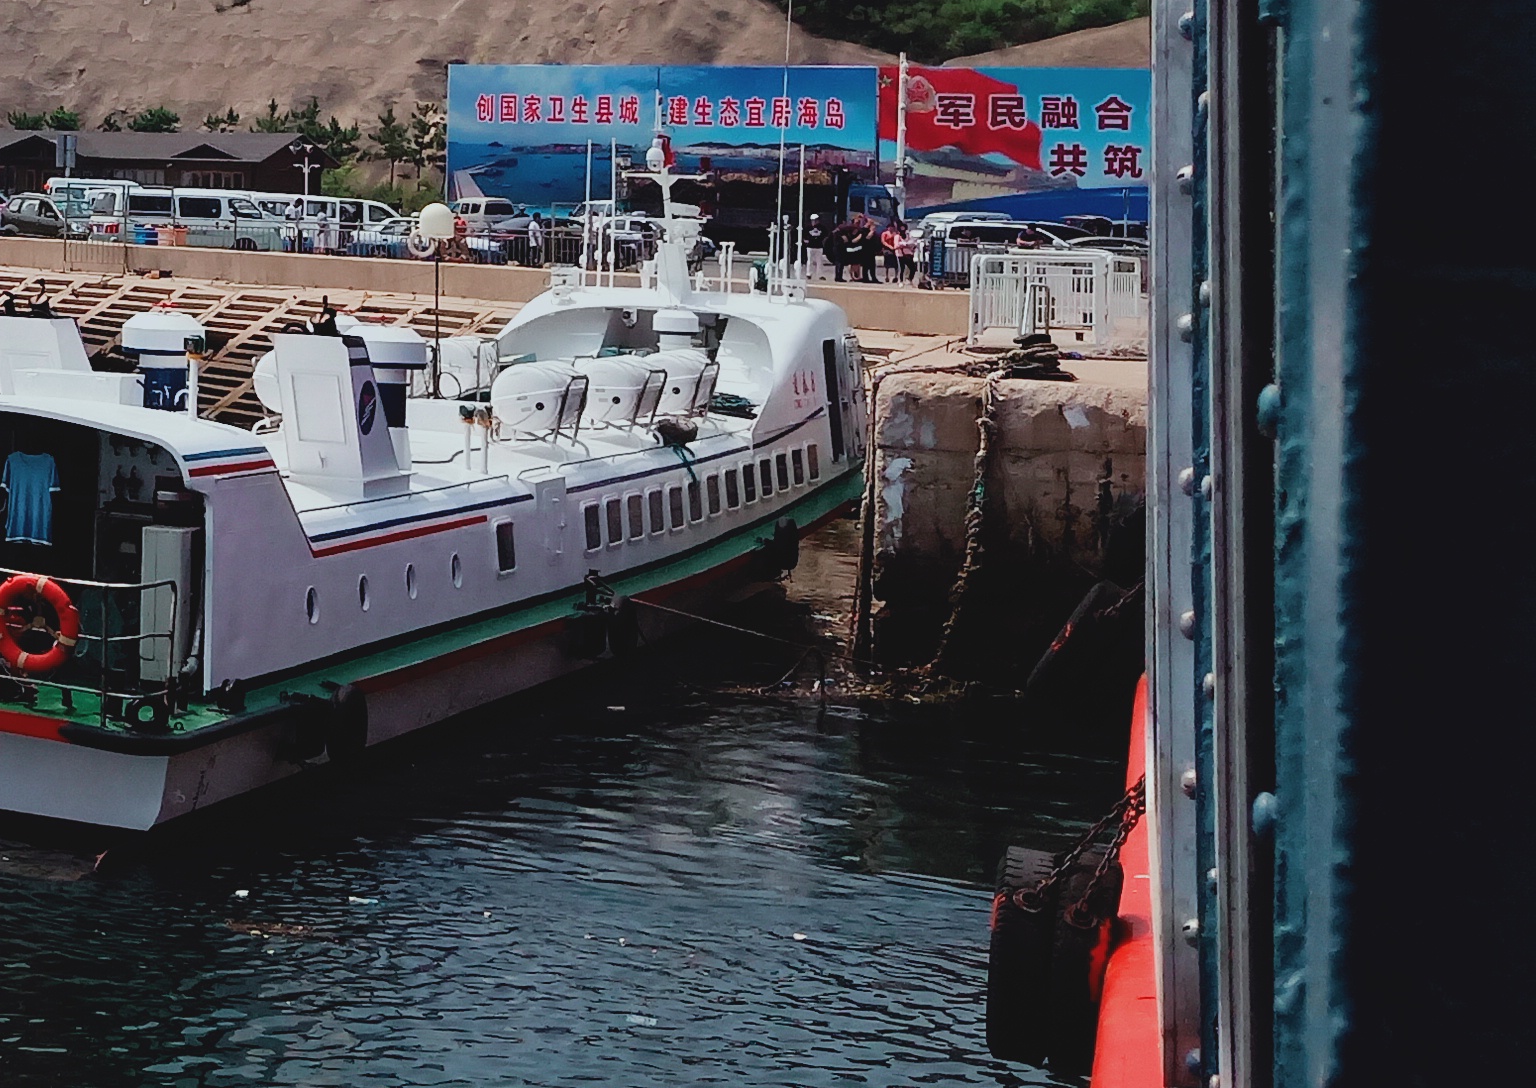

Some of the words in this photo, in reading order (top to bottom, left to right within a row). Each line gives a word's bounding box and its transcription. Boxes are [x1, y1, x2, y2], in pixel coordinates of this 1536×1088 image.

[476, 94, 640, 125] 创国家卫生县城
[667, 96, 845, 129] 建生态宜居海岛
[934, 95, 1133, 131] 军民融合
[1049, 143, 1143, 179] 共筑
